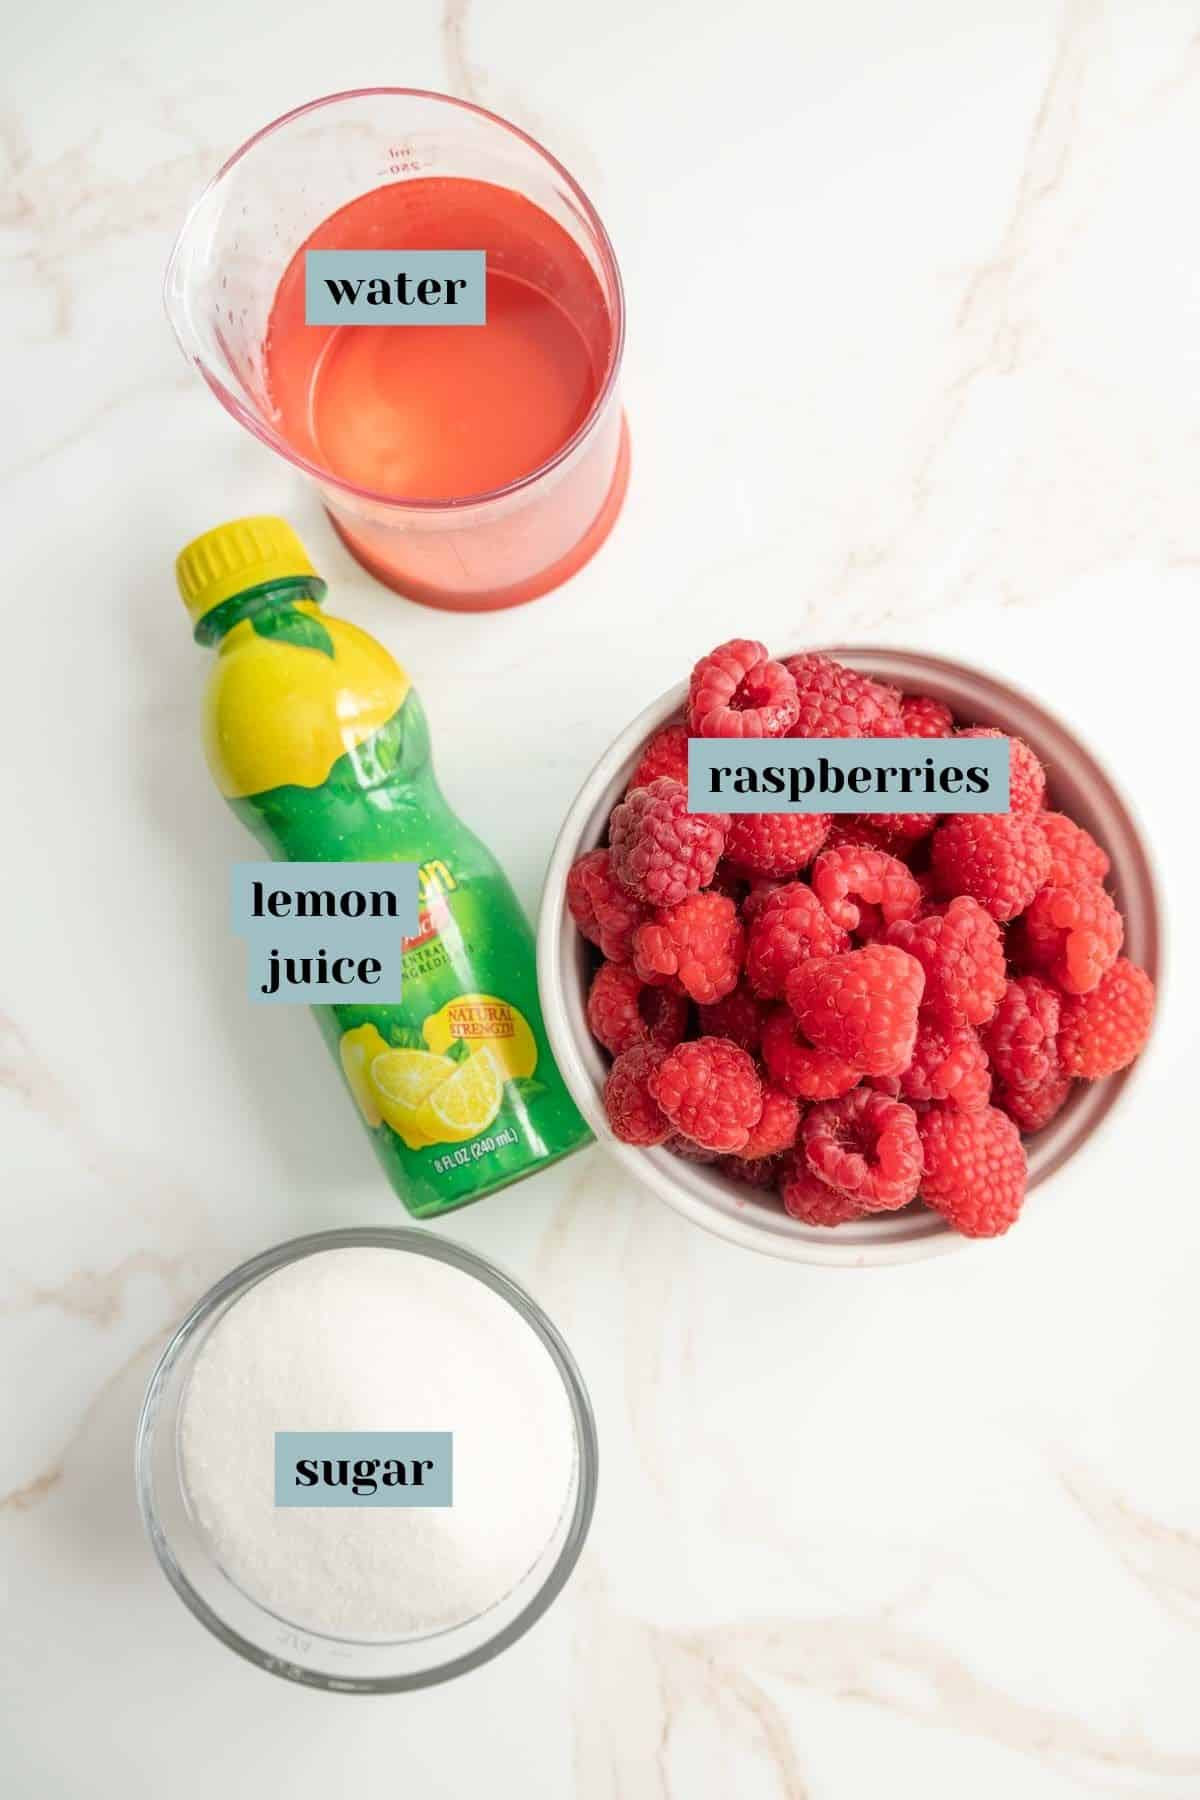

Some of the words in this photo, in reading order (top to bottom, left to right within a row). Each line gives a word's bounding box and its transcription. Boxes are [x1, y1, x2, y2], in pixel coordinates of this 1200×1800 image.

[448, 1006, 513, 1022] NATURAL
[449, 1022, 515, 1035] STRENGTH
[433, 1159, 444, 1174] 8
[470, 1136, 496, 1161] (240
